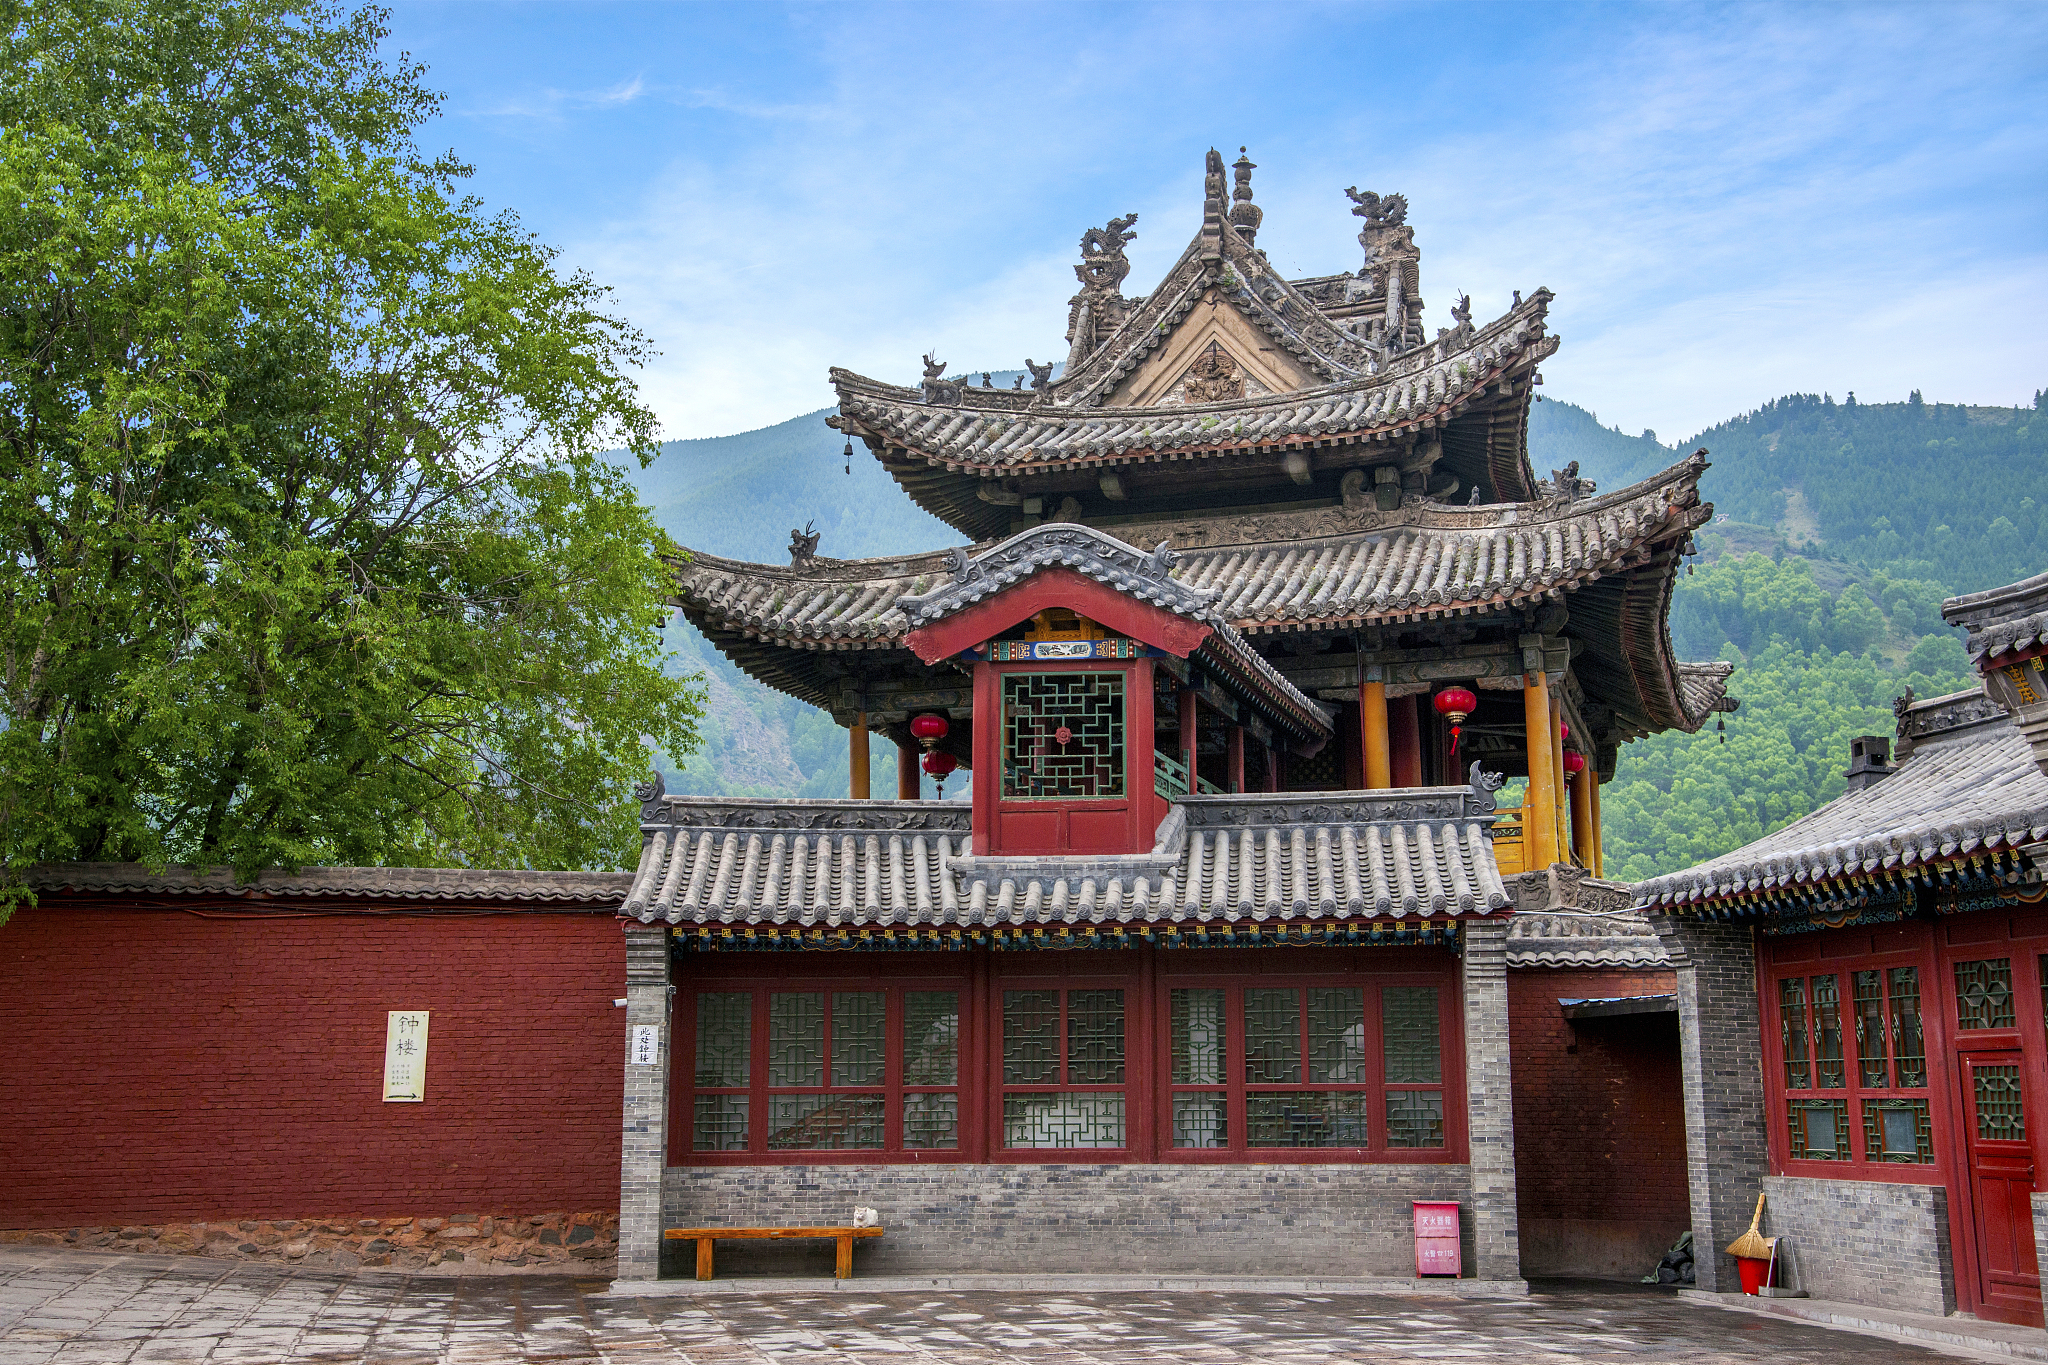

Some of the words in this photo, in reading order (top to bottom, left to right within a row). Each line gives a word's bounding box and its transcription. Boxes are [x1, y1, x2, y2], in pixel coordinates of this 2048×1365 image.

[396, 1015, 419, 1056] 钟楼
[1422, 1216, 1452, 1226] 灭火器箱
